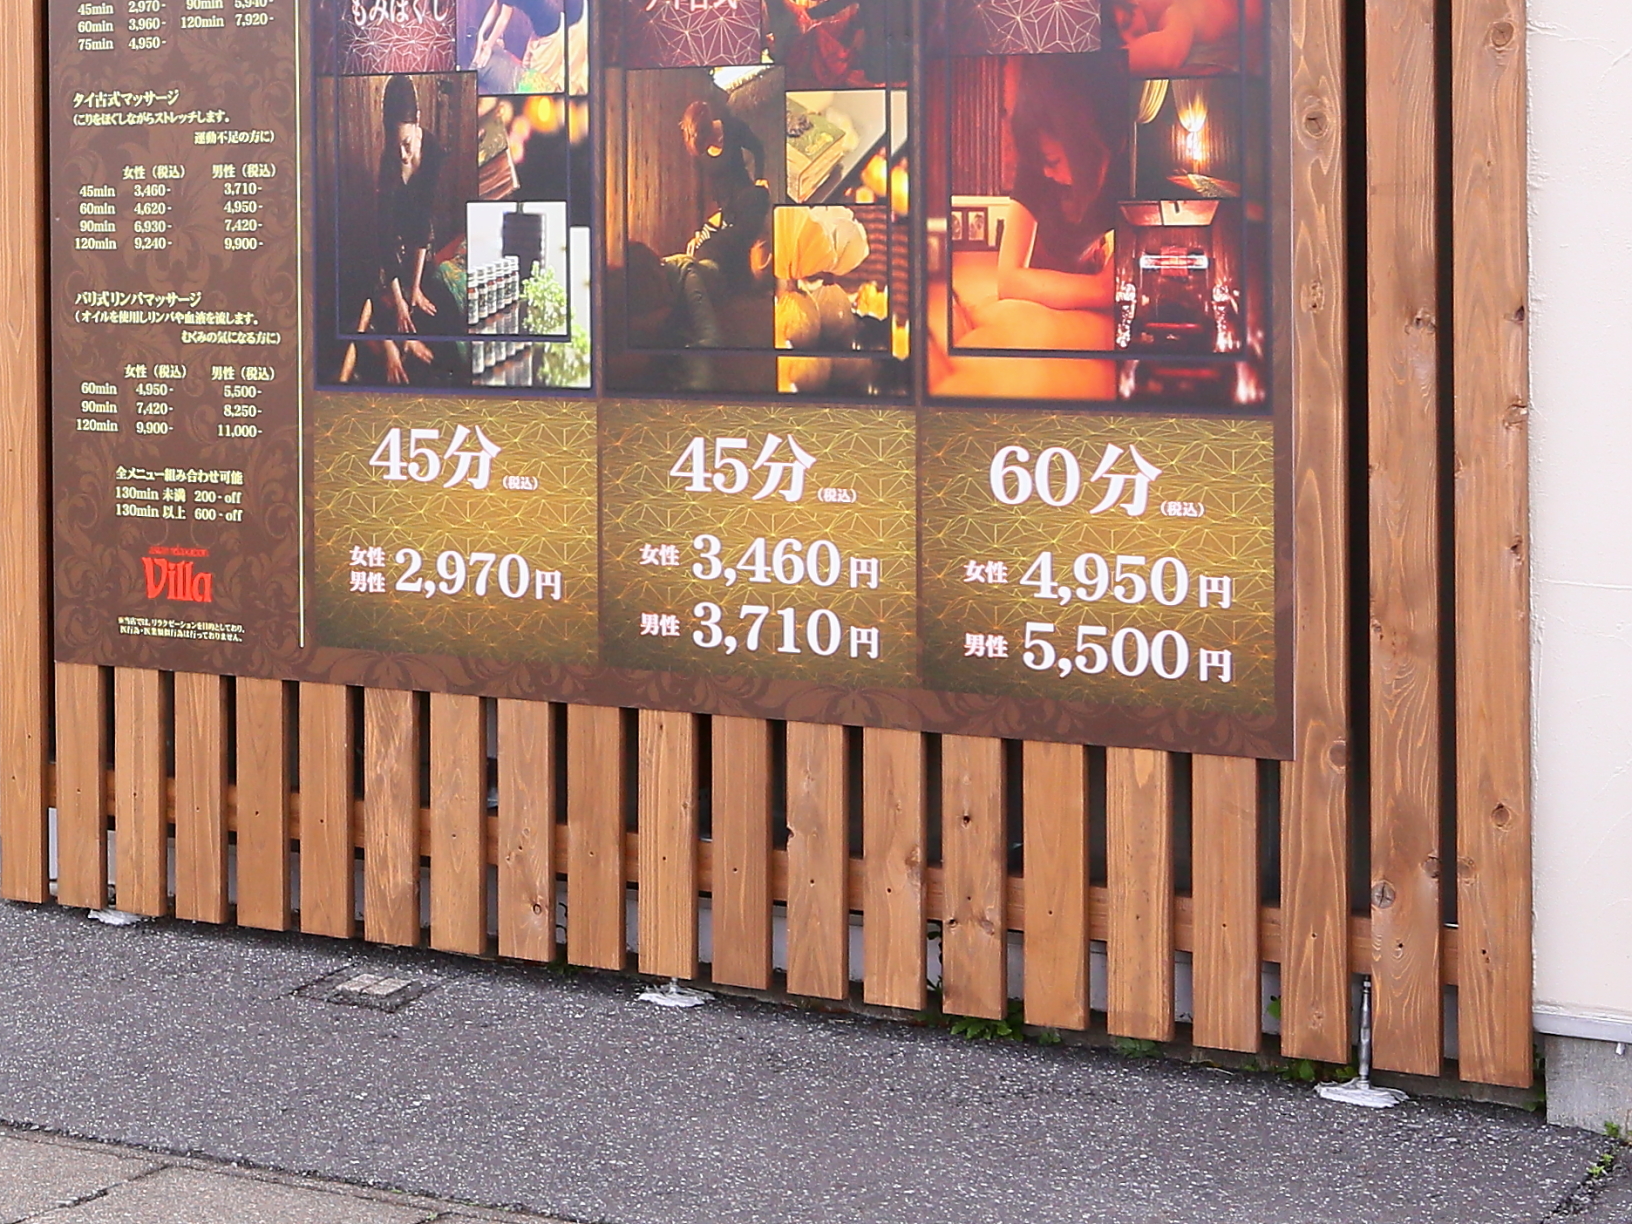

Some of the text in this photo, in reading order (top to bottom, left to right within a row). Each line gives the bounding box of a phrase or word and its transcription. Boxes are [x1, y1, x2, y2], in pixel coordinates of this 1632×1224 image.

[77, 2, 114, 16] 45min
[77, 19, 114, 33] 60min
[180, 14, 225, 29] 120min
[77, 37, 114, 51] 75min
[73, 89, 180, 108] タイ古式マッサージ
[79, 184, 116, 198] 45min
[79, 202, 116, 215] 60min
[79, 219, 116, 232] 90min
[75, 237, 117, 250] 120min
[74, 290, 202, 308] バリ式リンパマッサージ
[81, 382, 118, 395] 60min
[81, 400, 118, 414] 90min
[76, 418, 119, 432] 120min
[368, 424, 502, 490] 45分
[115, 465, 243, 485] 全メニュー組み合わせ可能
[669, 433, 817, 502] 45分
[989, 443, 1164, 517] 60分
[115, 486, 160, 501] 130min
[116, 503, 160, 518] 130min
[162, 505, 186, 520] 以上
[349, 545, 386, 568] 女性
[638, 534, 879, 589] 女性 3,460円
[142, 556, 213, 602] Villa
[349, 548, 562, 600] 男性 2,970円
[963, 551, 1231, 609] 女性 4,950円
[640, 601, 879, 659] 男性 3,710円
[963, 621, 1232, 683] 男性 5,500円
